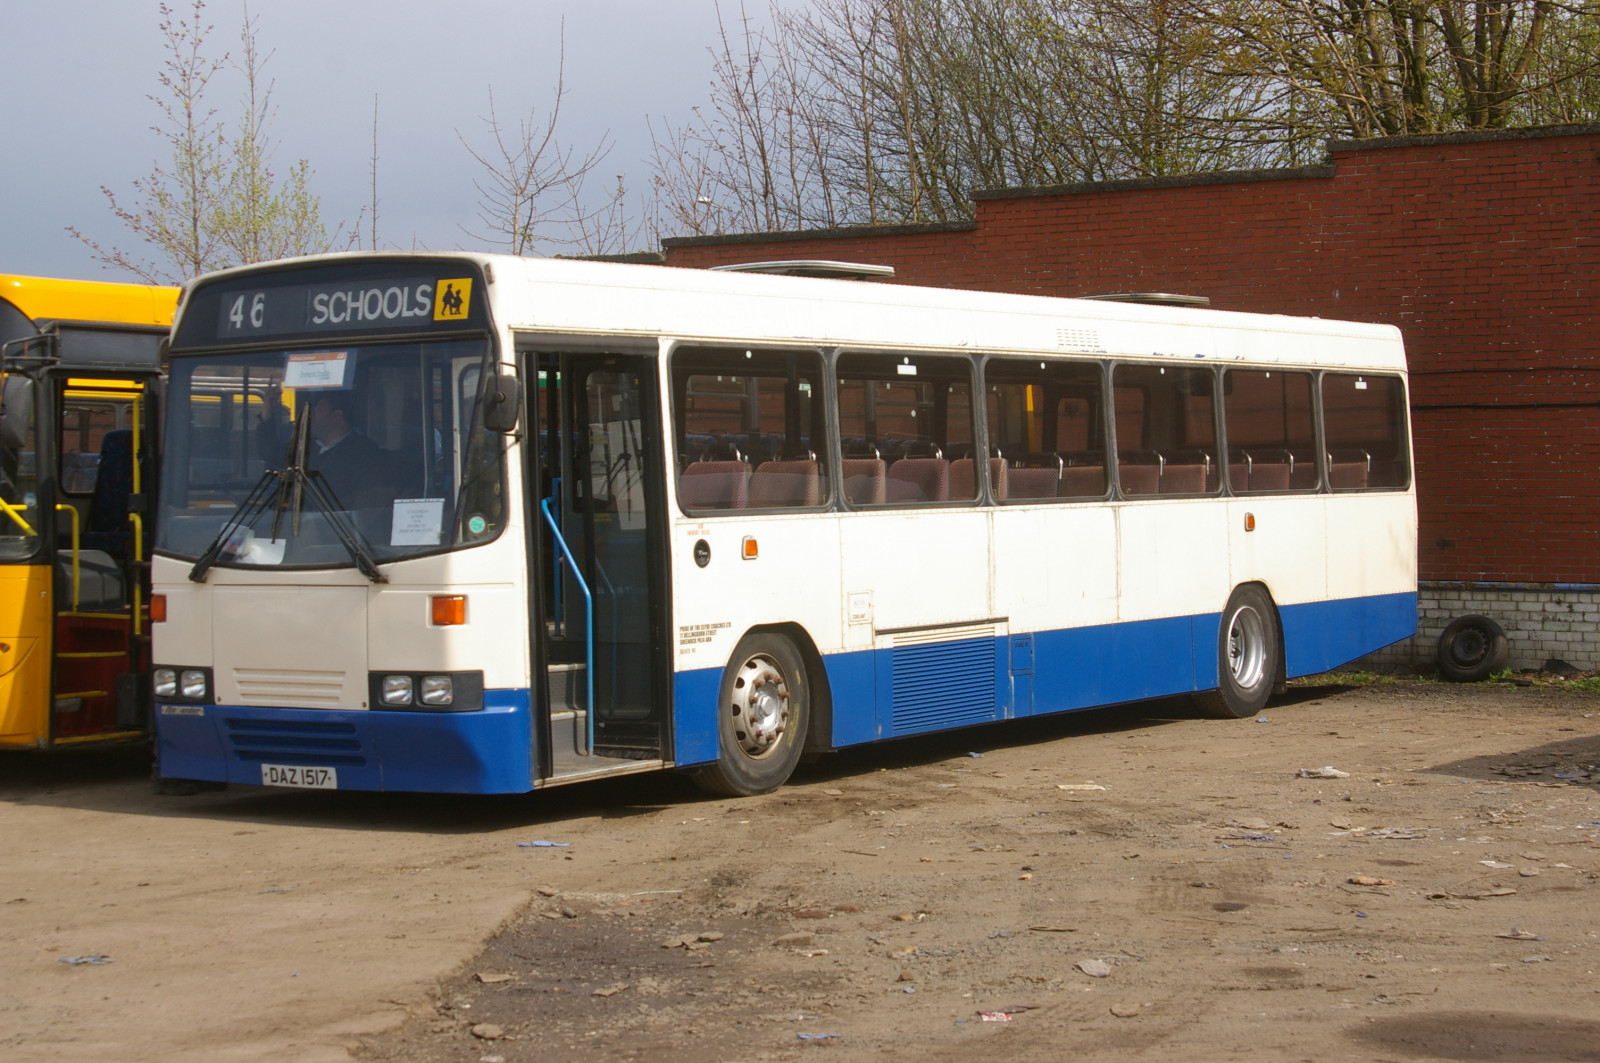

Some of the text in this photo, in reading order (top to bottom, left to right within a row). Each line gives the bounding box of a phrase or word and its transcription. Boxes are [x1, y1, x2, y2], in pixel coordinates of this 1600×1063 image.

[229, 284, 433, 329] 46 SCHOOLS
[269, 767, 328, 786] DAZ 1517
